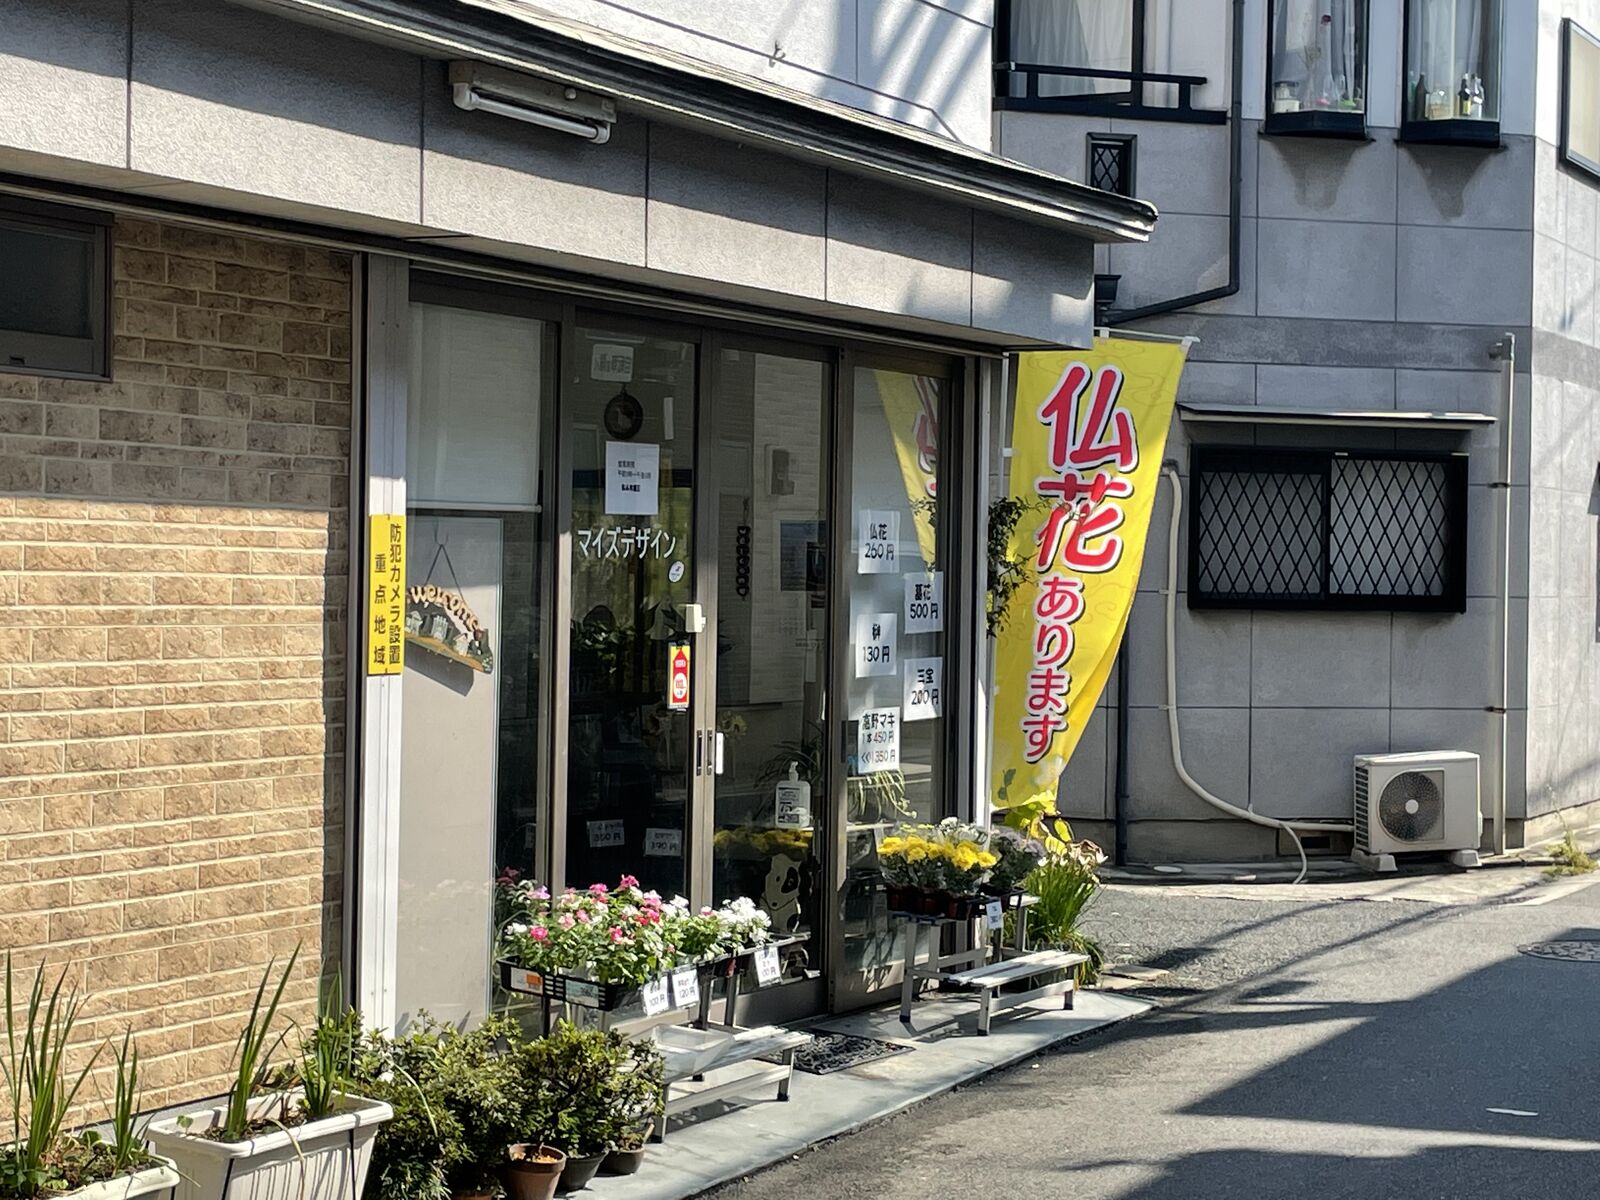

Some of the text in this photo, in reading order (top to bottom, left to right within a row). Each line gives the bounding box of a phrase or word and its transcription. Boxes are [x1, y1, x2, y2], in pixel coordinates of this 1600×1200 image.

[869, 523, 888, 541] 仏花
[577, 526, 677, 560] マイズデザイン
[864, 542, 895, 561] 260円
[1021, 361, 1139, 764] 仏花あります
[389, 523, 402, 665] 防犯カメラ設置
[373, 553, 387, 664] 重点地域
[910, 602, 939, 620] 500円
[862, 645, 890, 663] 130円
[911, 688, 939, 706] 200円
